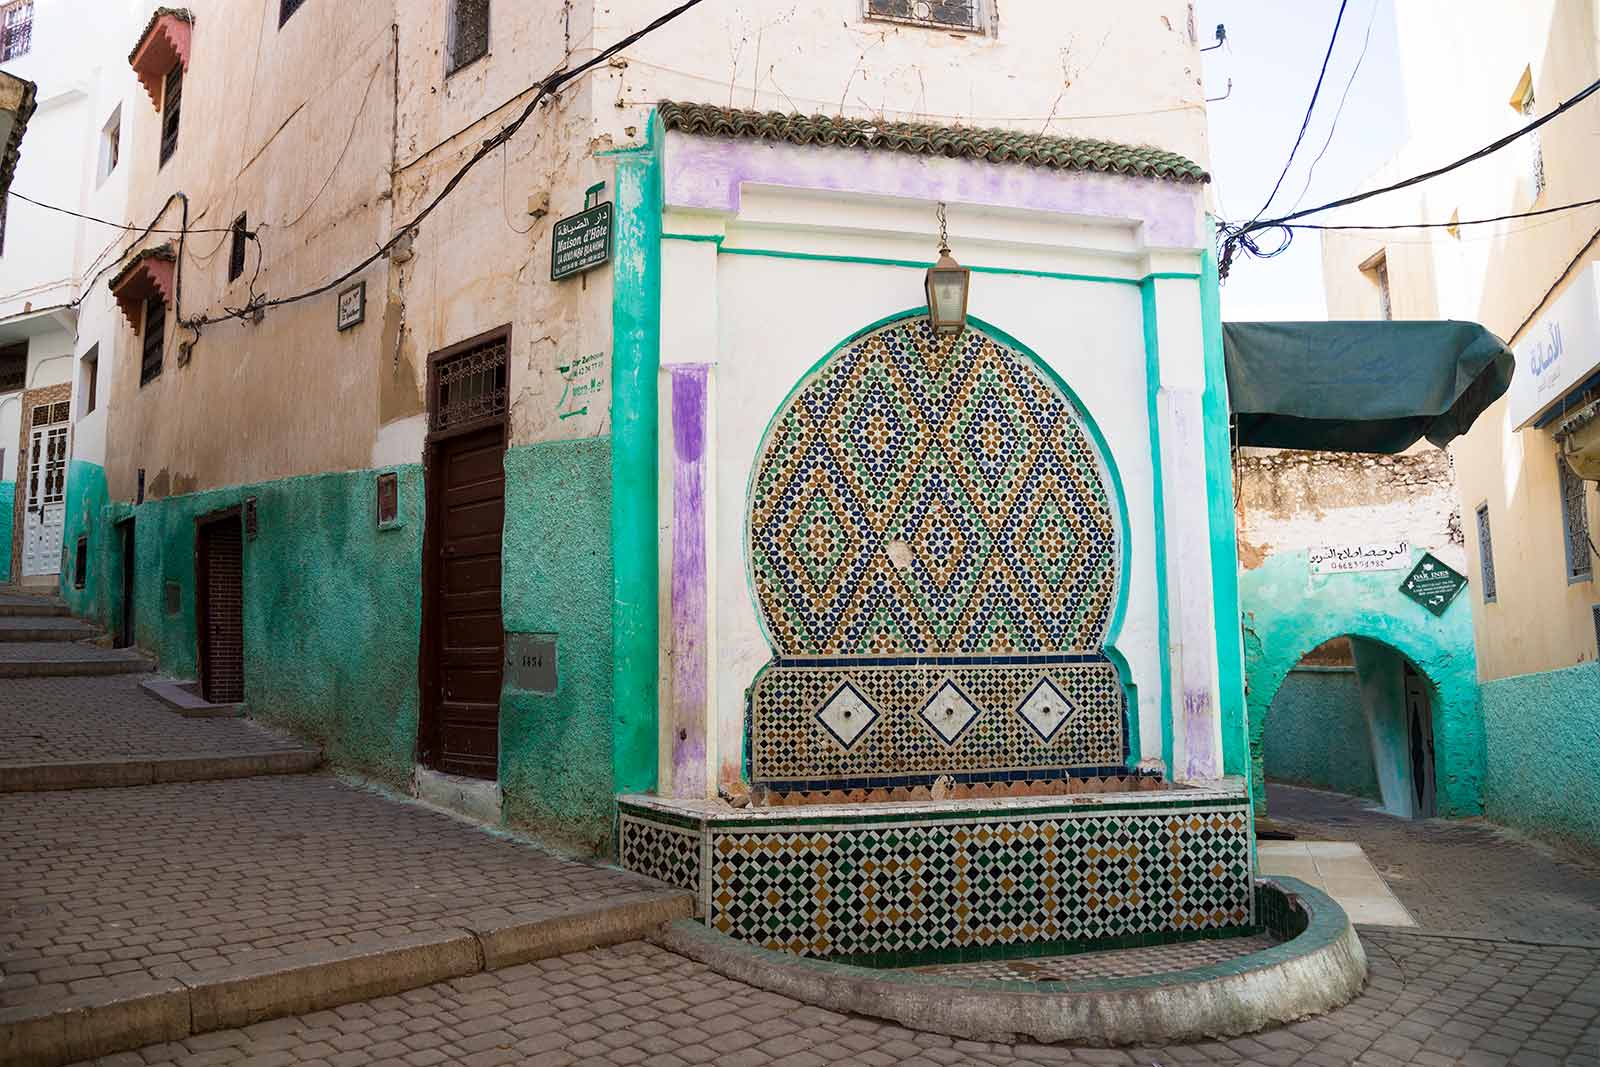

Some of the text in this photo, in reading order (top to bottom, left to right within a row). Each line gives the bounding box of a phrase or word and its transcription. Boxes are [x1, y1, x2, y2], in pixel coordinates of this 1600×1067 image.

[558, 211, 608, 236] دار الضيافة
[556, 235, 582, 254] Maison
